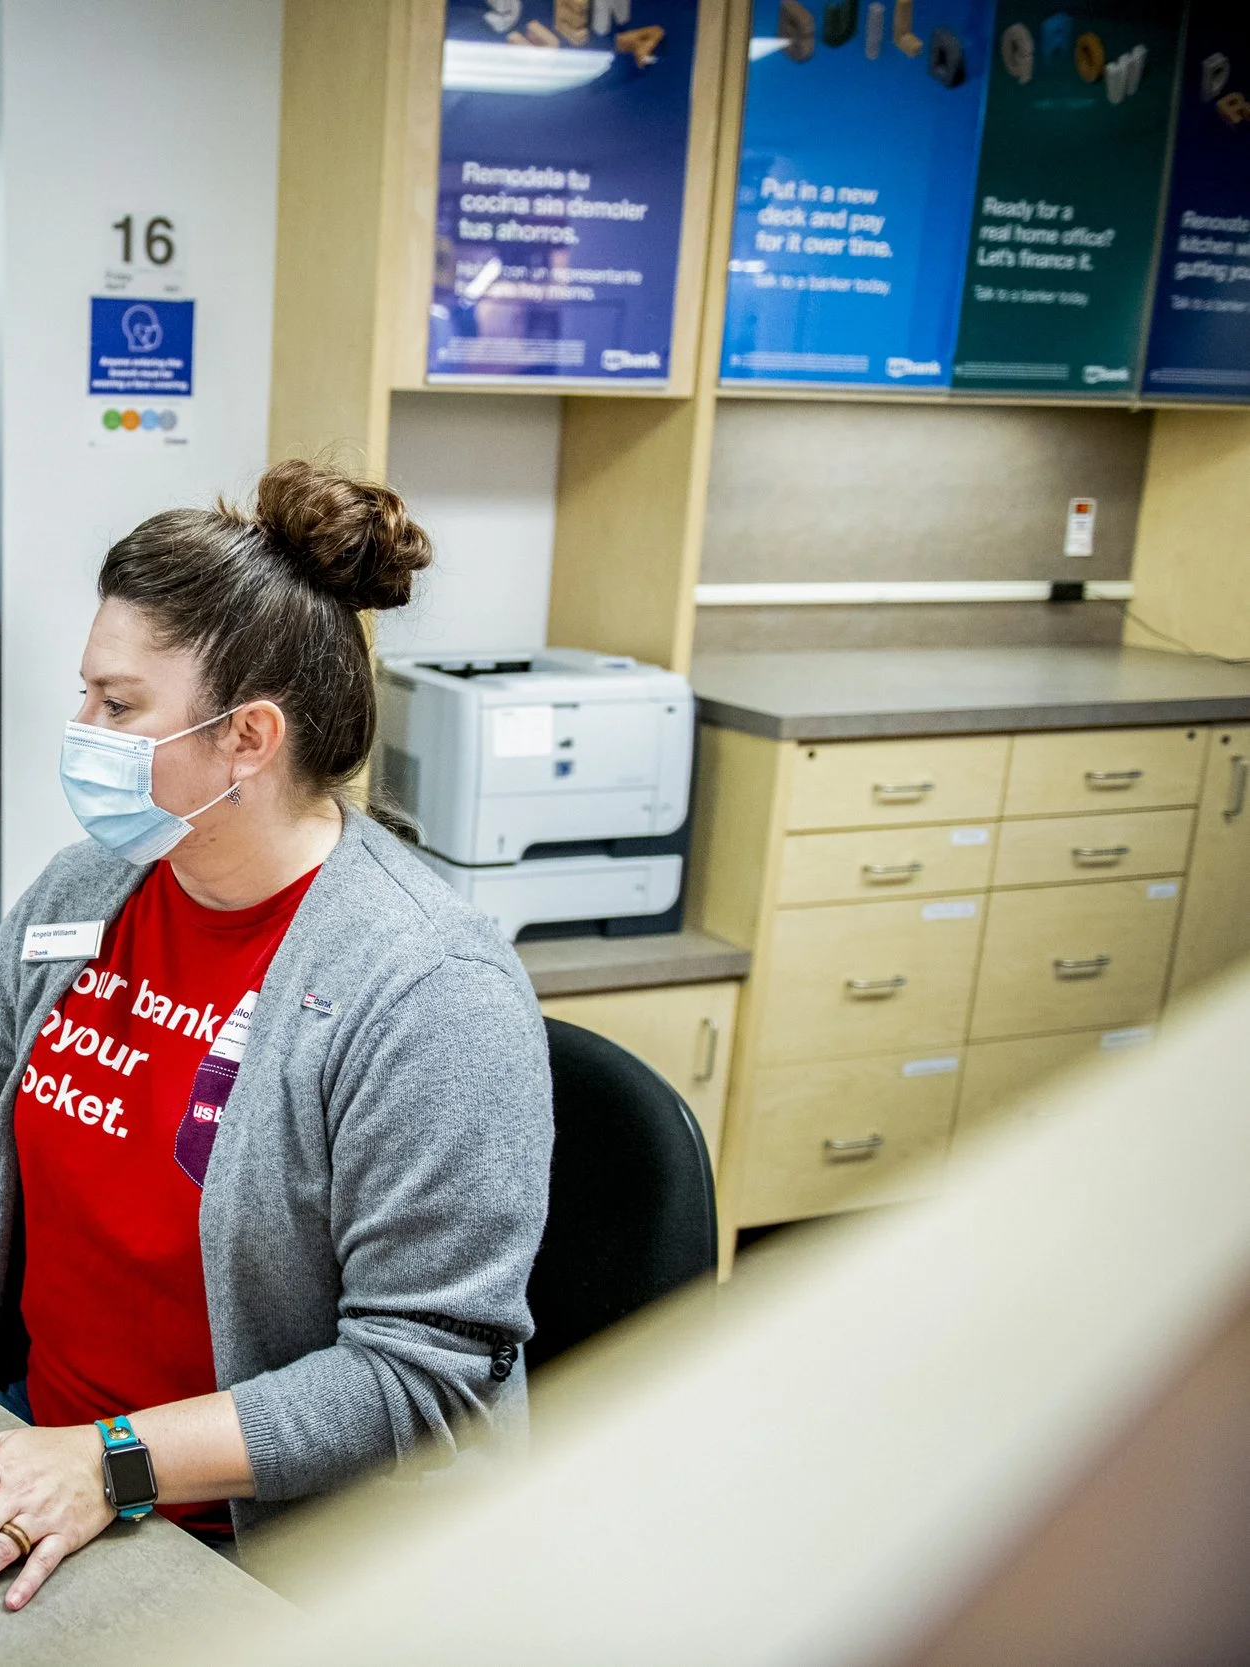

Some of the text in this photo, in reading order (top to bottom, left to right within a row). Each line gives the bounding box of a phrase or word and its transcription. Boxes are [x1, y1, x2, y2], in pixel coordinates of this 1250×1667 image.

[462, 161, 590, 190] Remodela tu
[760, 177, 879, 205] Put in a new
[460, 191, 648, 221] cocina sin demoler
[757, 204, 886, 236] deck and pay
[983, 196, 1074, 222] Ready for a
[112, 215, 175, 265] 16
[459, 218, 580, 245] tus ahorros.
[755, 230, 893, 258] for it over time.
[979, 223, 1116, 247] real home office?
[976, 246, 1094, 271] Let's finance it.
[52, 929, 77, 937] Williams
[71, 966, 223, 1043] our bank
[50, 1017, 150, 1077] your
[21, 1063, 129, 1139] ocket.
